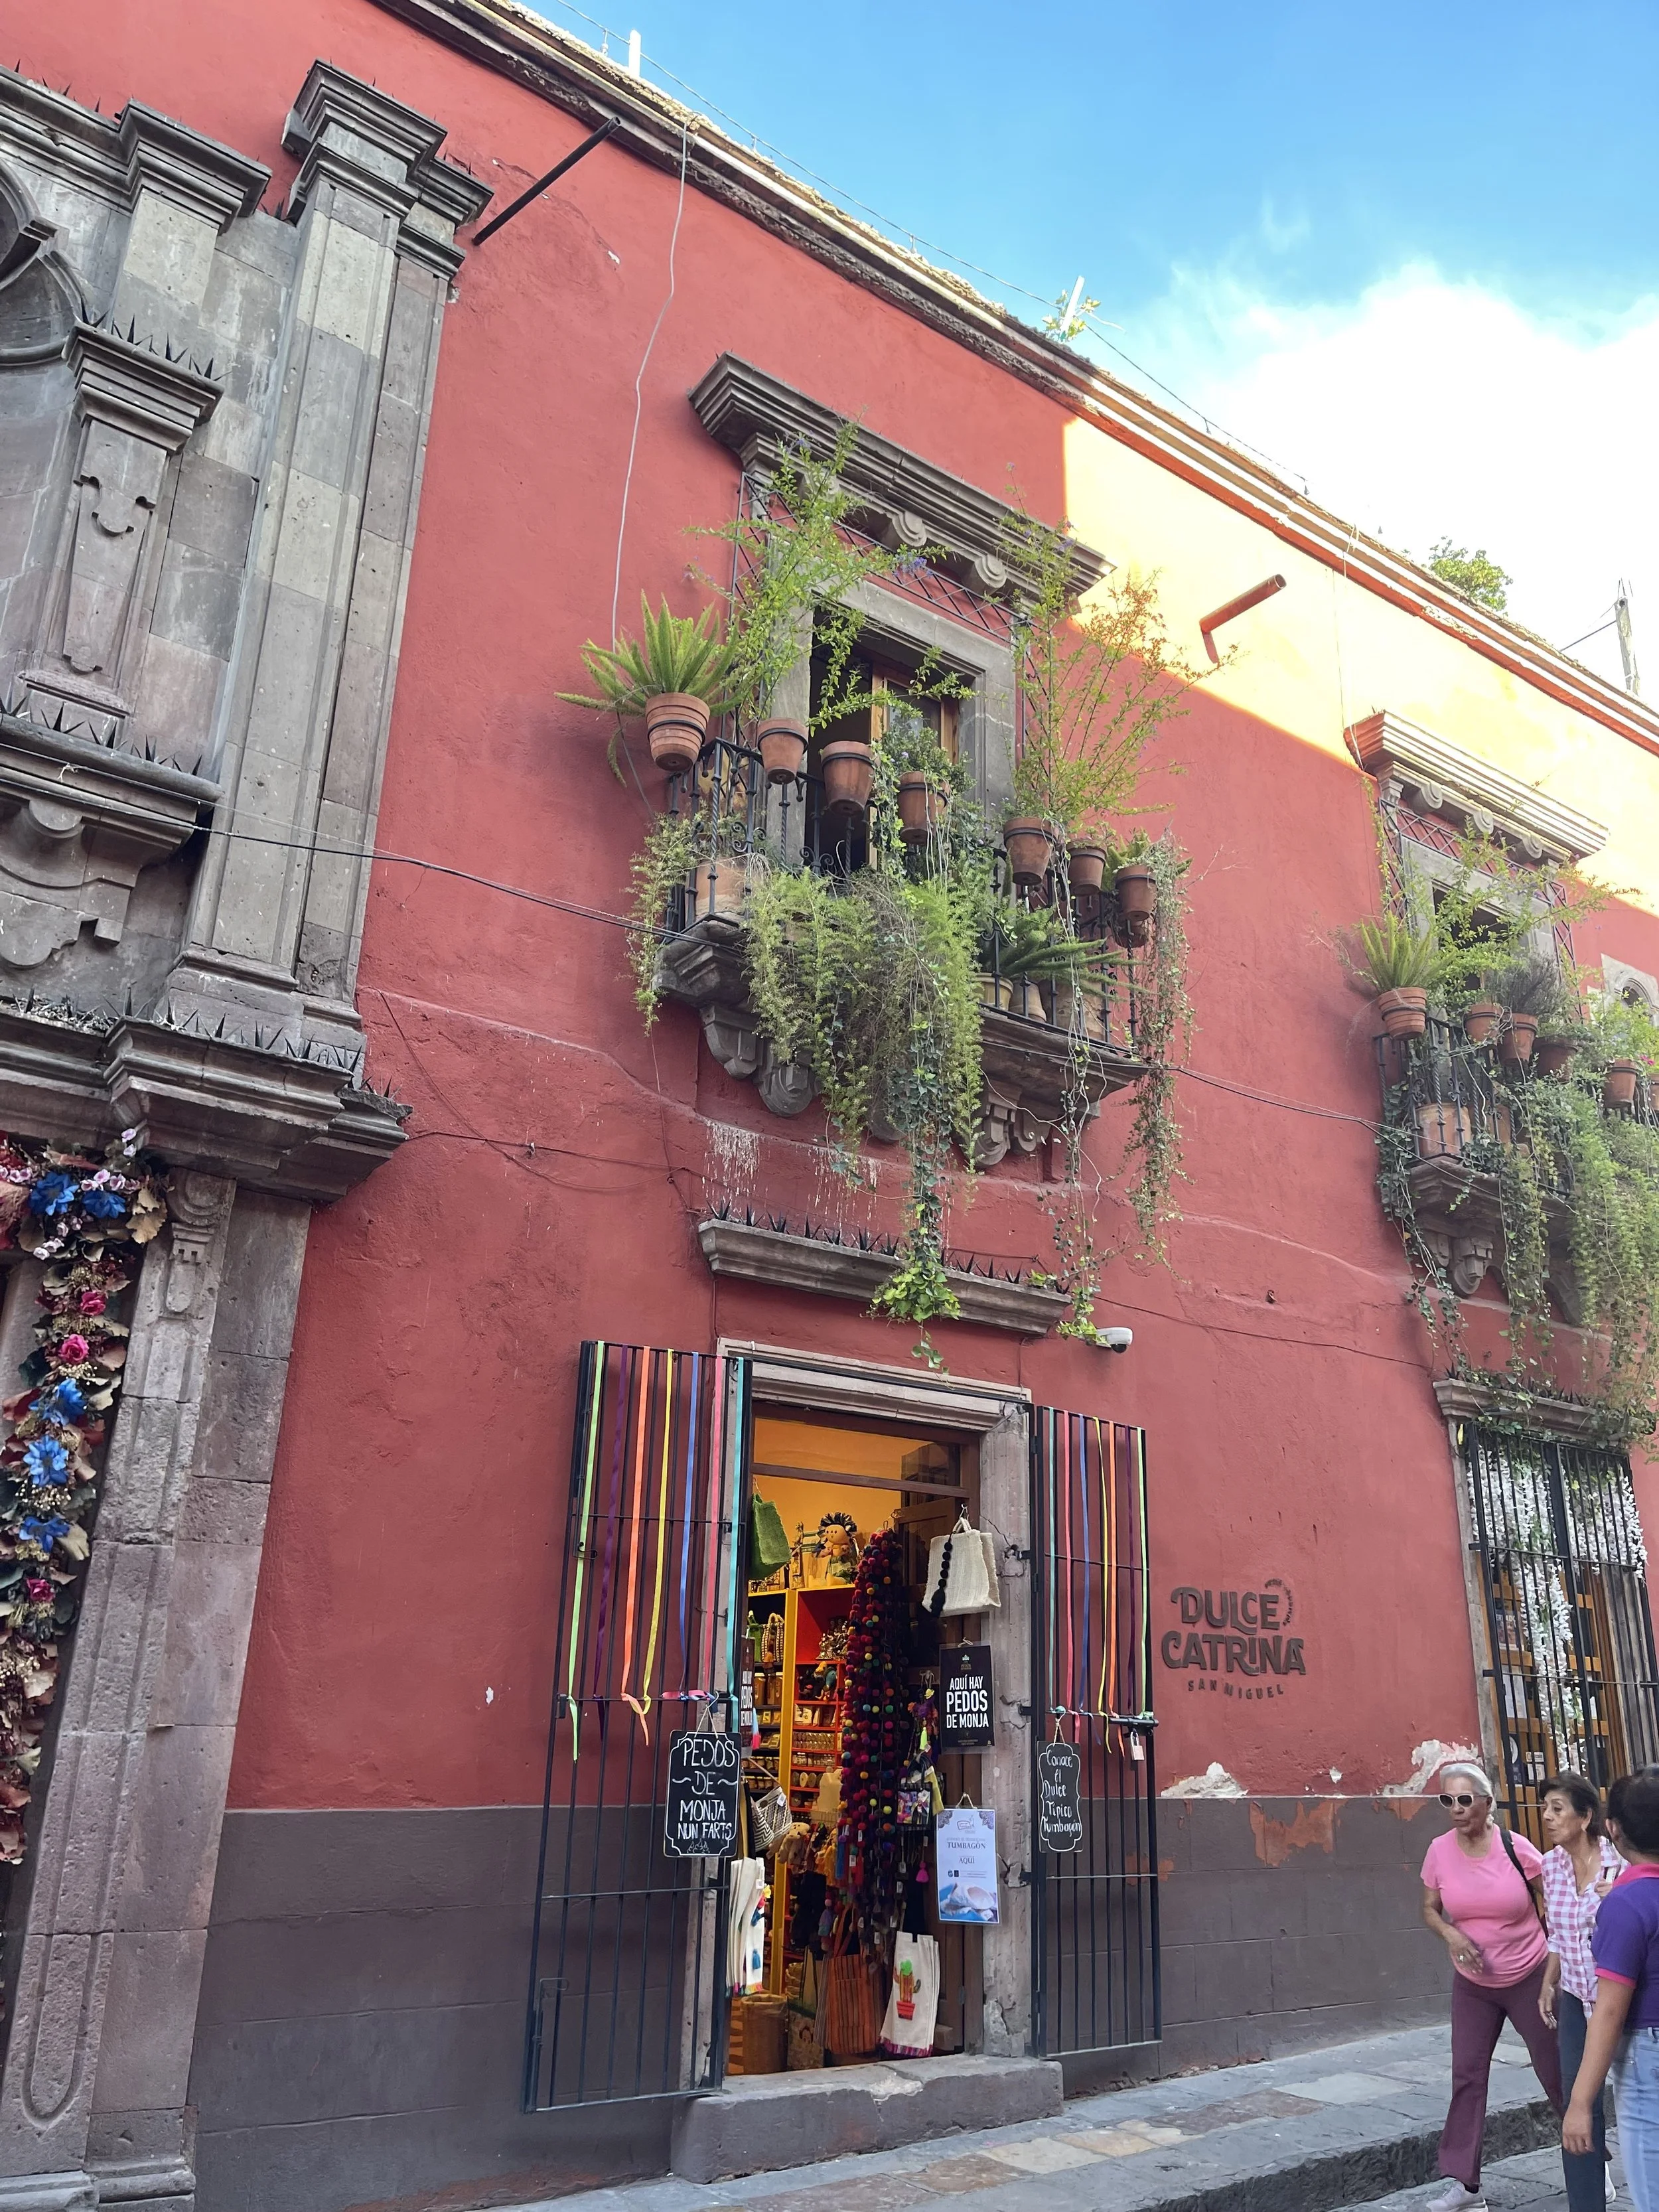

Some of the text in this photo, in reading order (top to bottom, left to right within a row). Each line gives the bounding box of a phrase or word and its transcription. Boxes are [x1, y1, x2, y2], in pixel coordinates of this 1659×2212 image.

[1171, 1587, 1280, 1635] DULCE
[1162, 1631, 1306, 1676] CATRINA
[950, 1674, 983, 1690] AQUÍ HAY
[1188, 1678, 1283, 1700] SAN MIGUEL
[946, 1690, 988, 1712] PEDOS
[946, 1713, 989, 1729] DE MONJA
[680, 1738, 736, 1767] PEDOS
[1046, 1749, 1073, 1768] Conoce
[691, 1771, 716, 1795] DE
[1044, 1779, 1067, 1798] Dulce
[680, 1799, 726, 1822] MONJA
[1046, 1801, 1072, 1819] Típico
[678, 1822, 732, 1840] NUN FARTS
[947, 1841, 986, 1850] TUMBAGÓN
